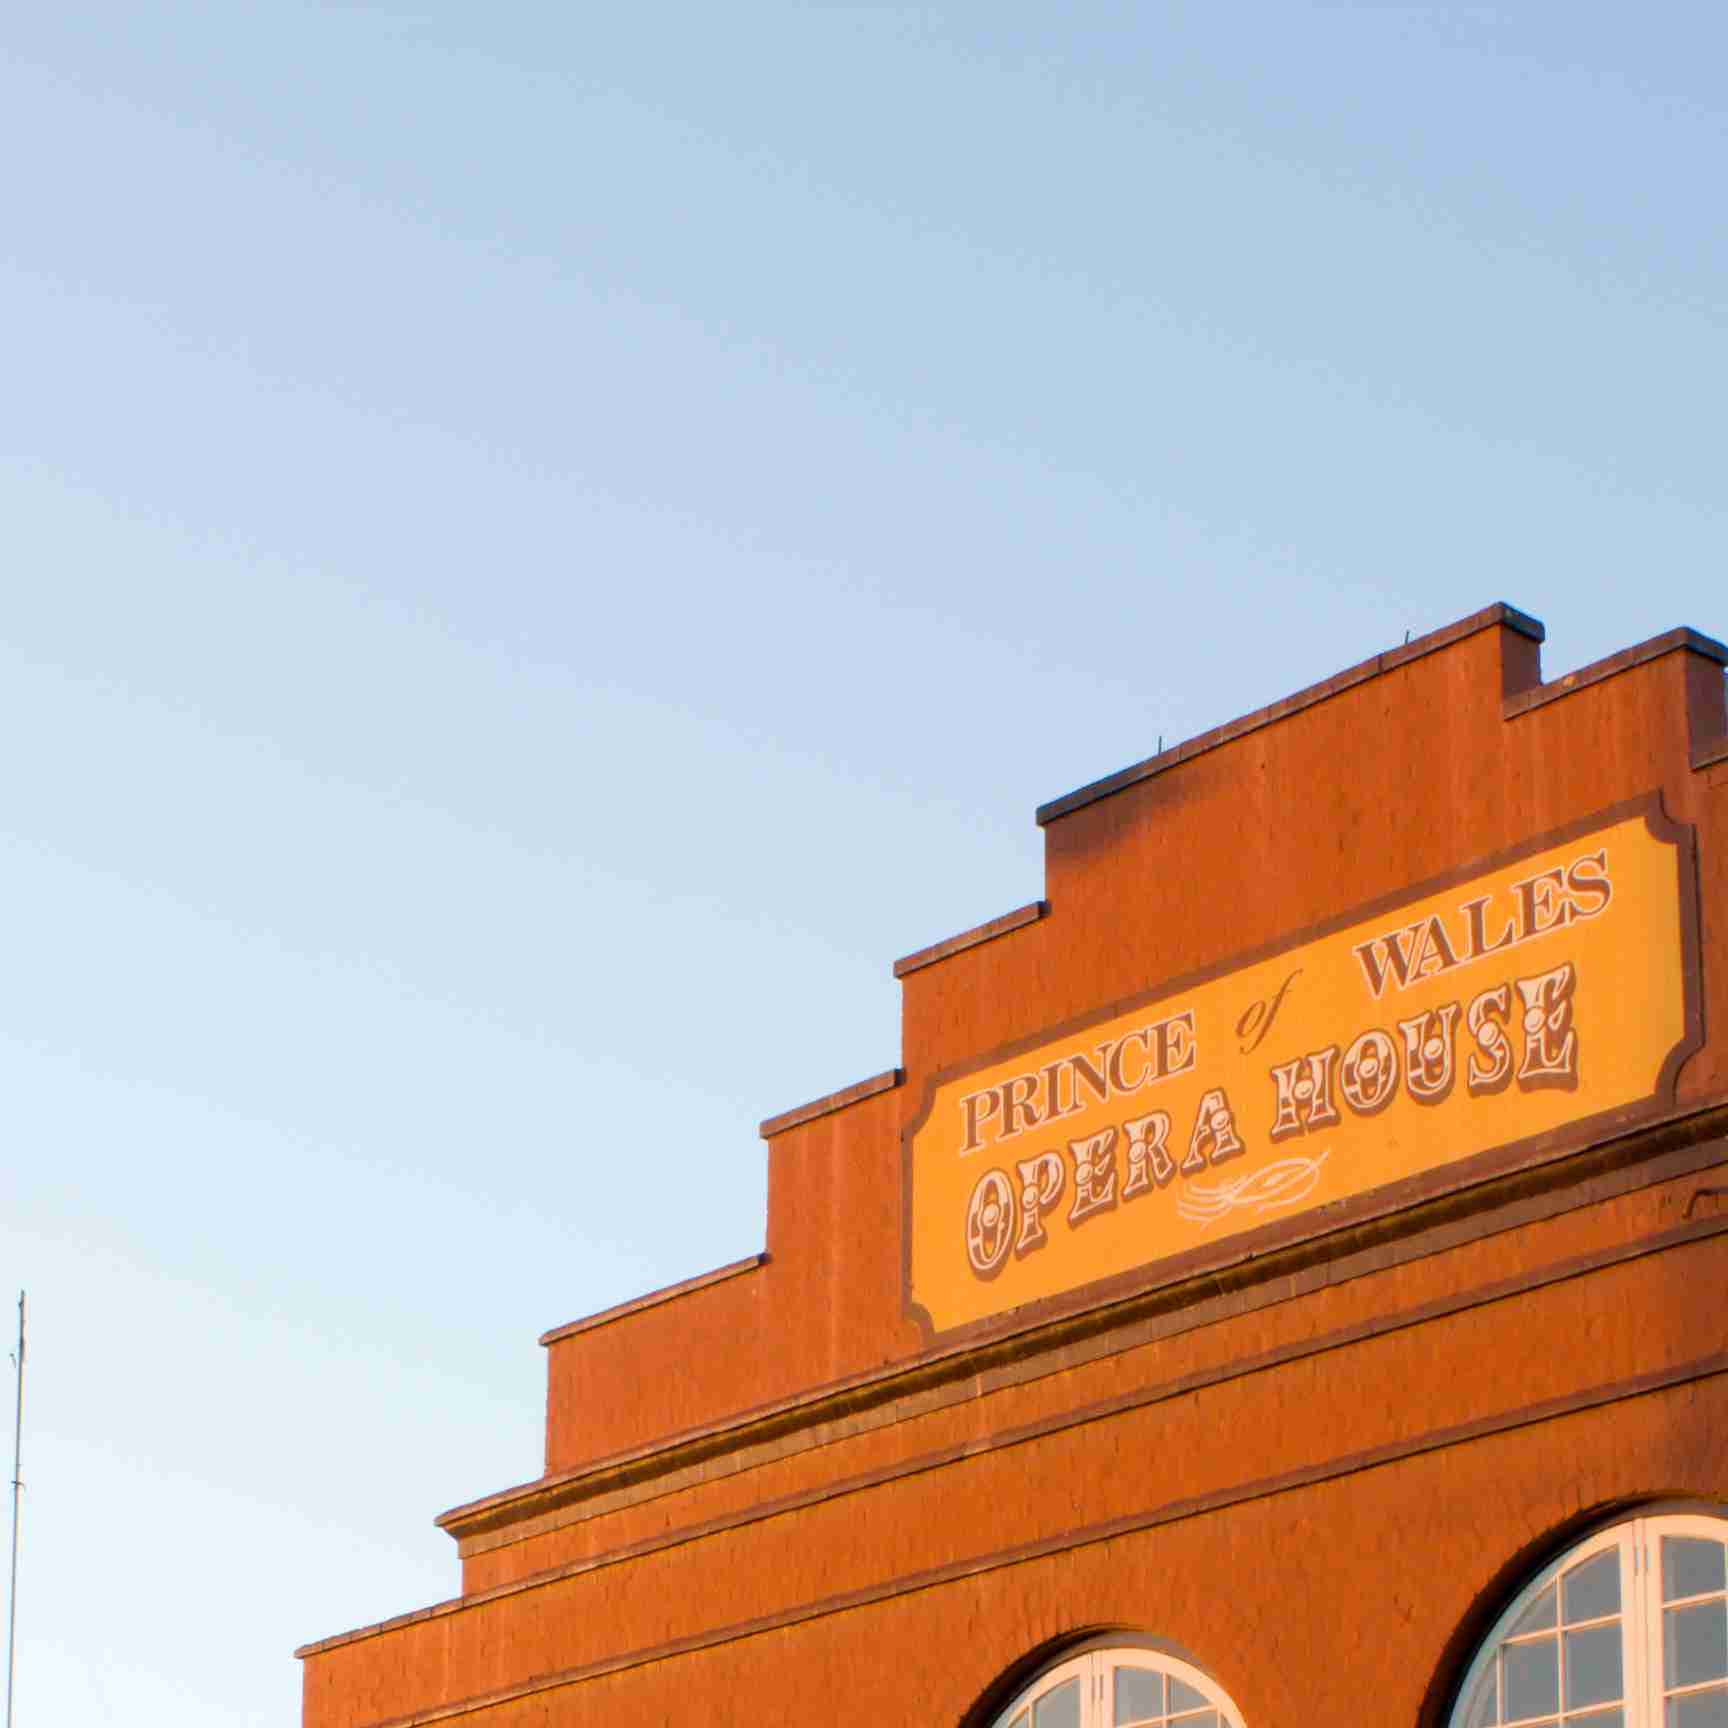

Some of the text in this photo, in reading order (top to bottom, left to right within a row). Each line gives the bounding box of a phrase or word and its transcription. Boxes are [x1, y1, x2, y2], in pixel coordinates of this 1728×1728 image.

[959, 847, 1614, 1158] PRINCE of WALES
[964, 962, 1579, 1283] OPERA HOUSE
